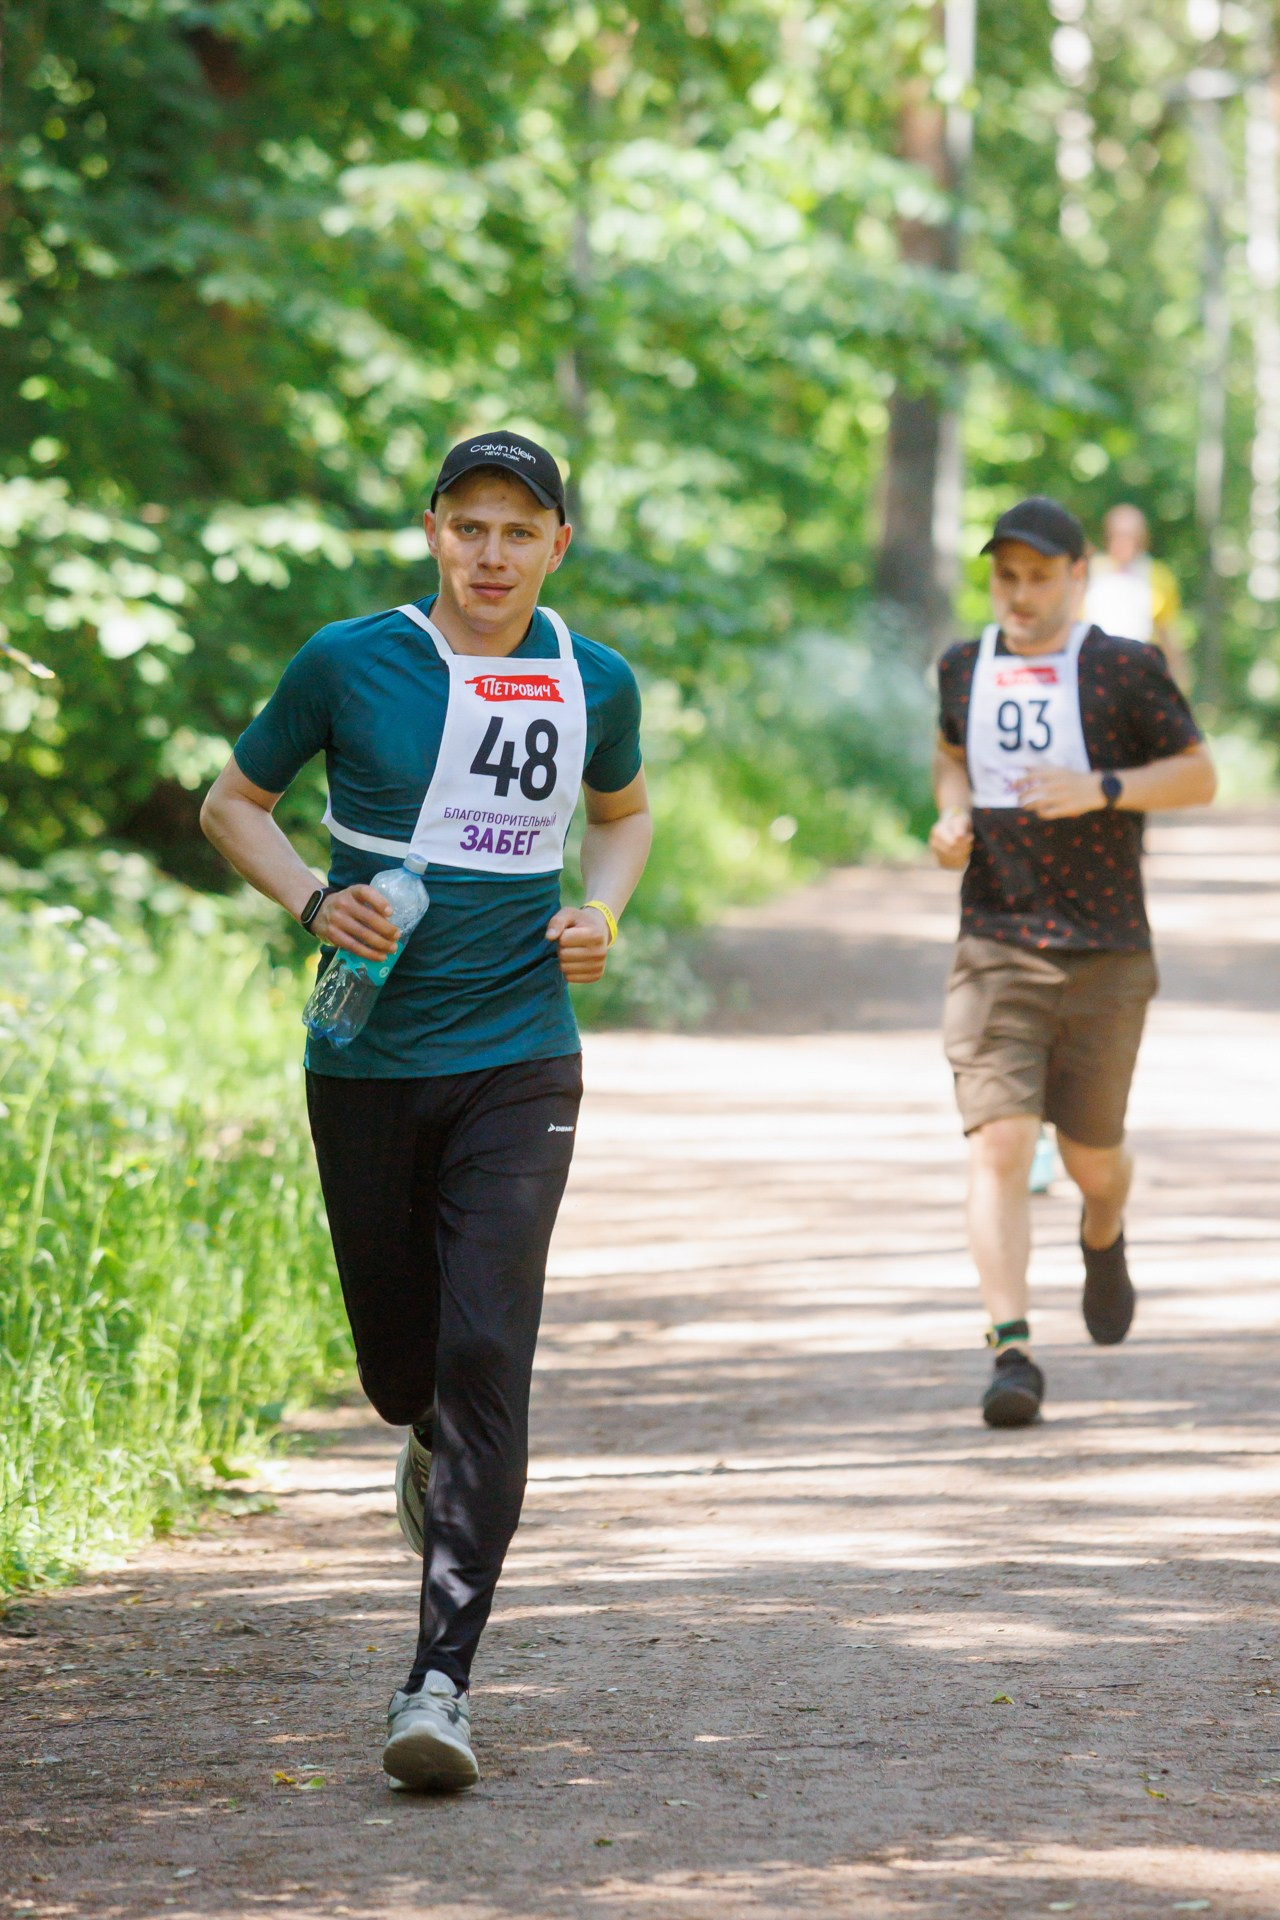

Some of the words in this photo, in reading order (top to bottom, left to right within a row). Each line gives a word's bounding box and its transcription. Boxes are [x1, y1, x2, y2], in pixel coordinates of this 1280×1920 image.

[470, 443, 509, 453] Calvin
[510, 445, 537, 464] Klein
[502, 452, 520, 462] YORK
[481, 677, 551, 698] ПЕТРОВИЧ
[997, 700, 1053, 751] 93
[469, 715, 559, 801] 48
[443, 807, 557, 827] БЛАГОТВОРИТЕЛЬНЫЙ
[460, 824, 541, 856] ЗАБЕГ
